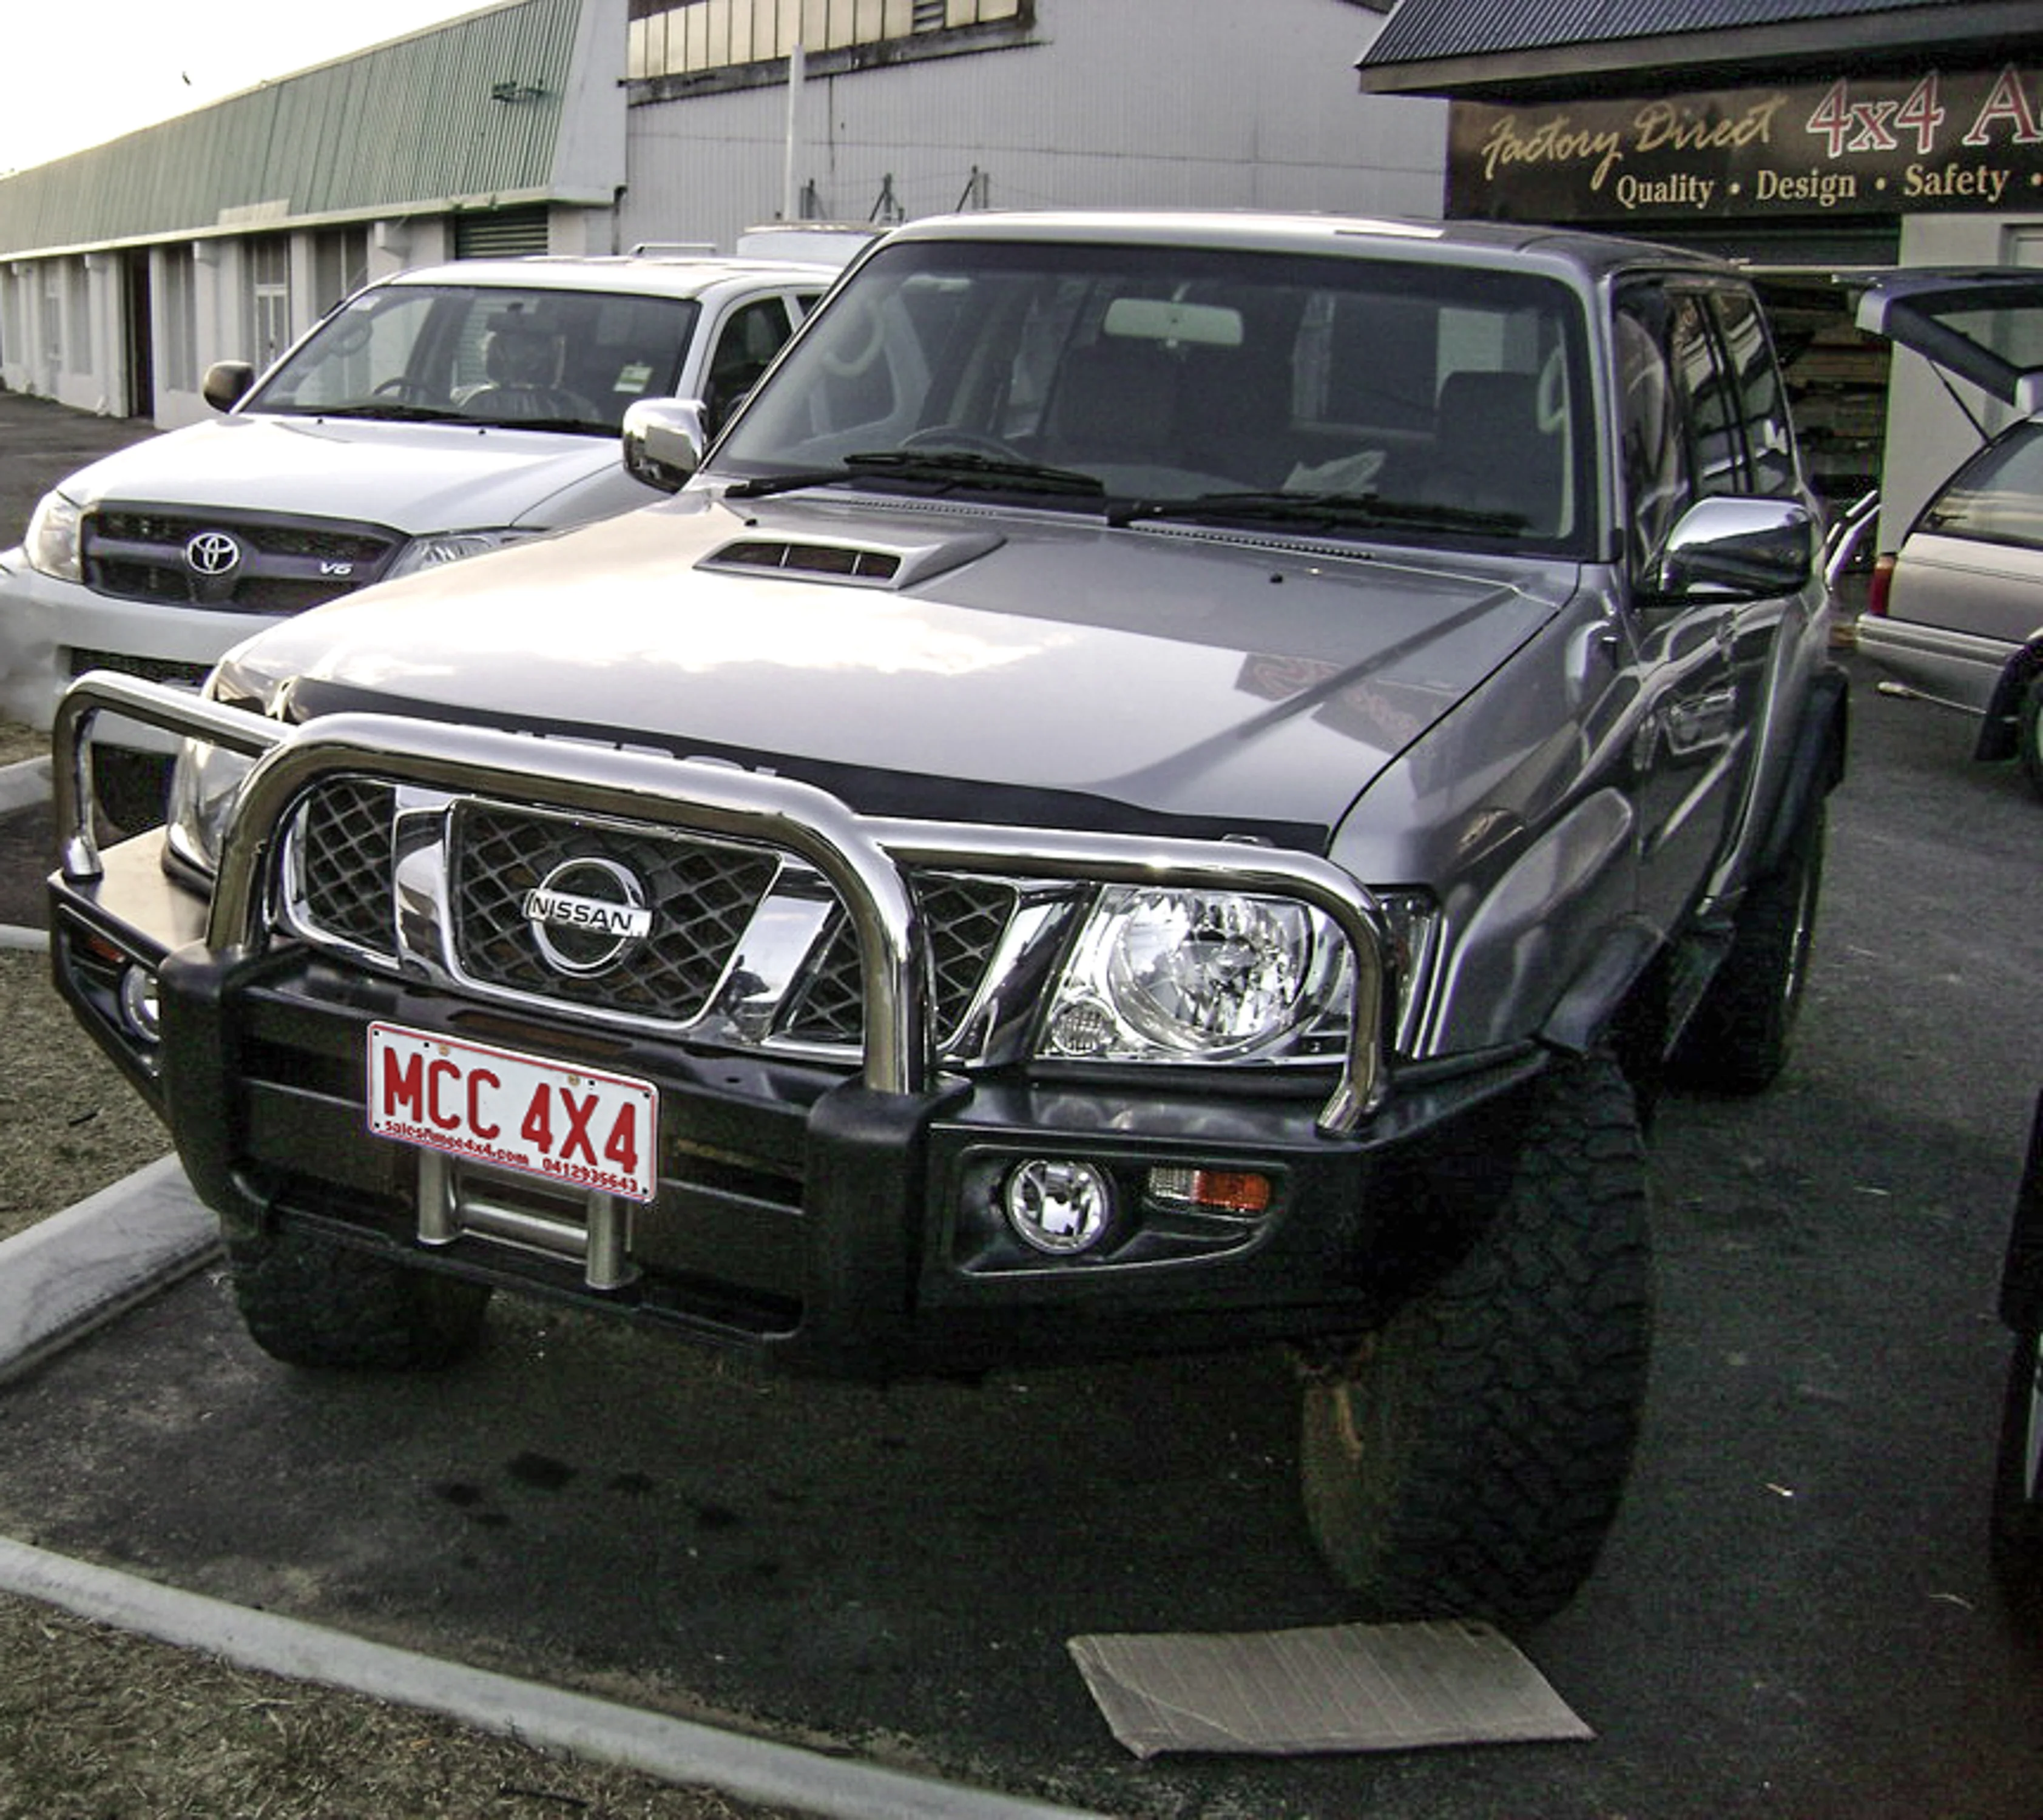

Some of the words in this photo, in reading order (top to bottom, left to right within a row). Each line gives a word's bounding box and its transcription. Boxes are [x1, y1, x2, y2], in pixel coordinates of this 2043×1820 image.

[1481, 114, 1624, 190] Factory
[1635, 100, 1789, 153] Direct
[1806, 76, 1945, 158] 4x4
[1616, 175, 1714, 207] Quality
[1756, 169, 1857, 207] Design
[1903, 164, 2010, 203] Safety
[321, 562, 353, 575] V6
[531, 898, 633, 930] NISSAN
[383, 1046, 501, 1140] MCC
[521, 1082, 638, 1175] 4X4
